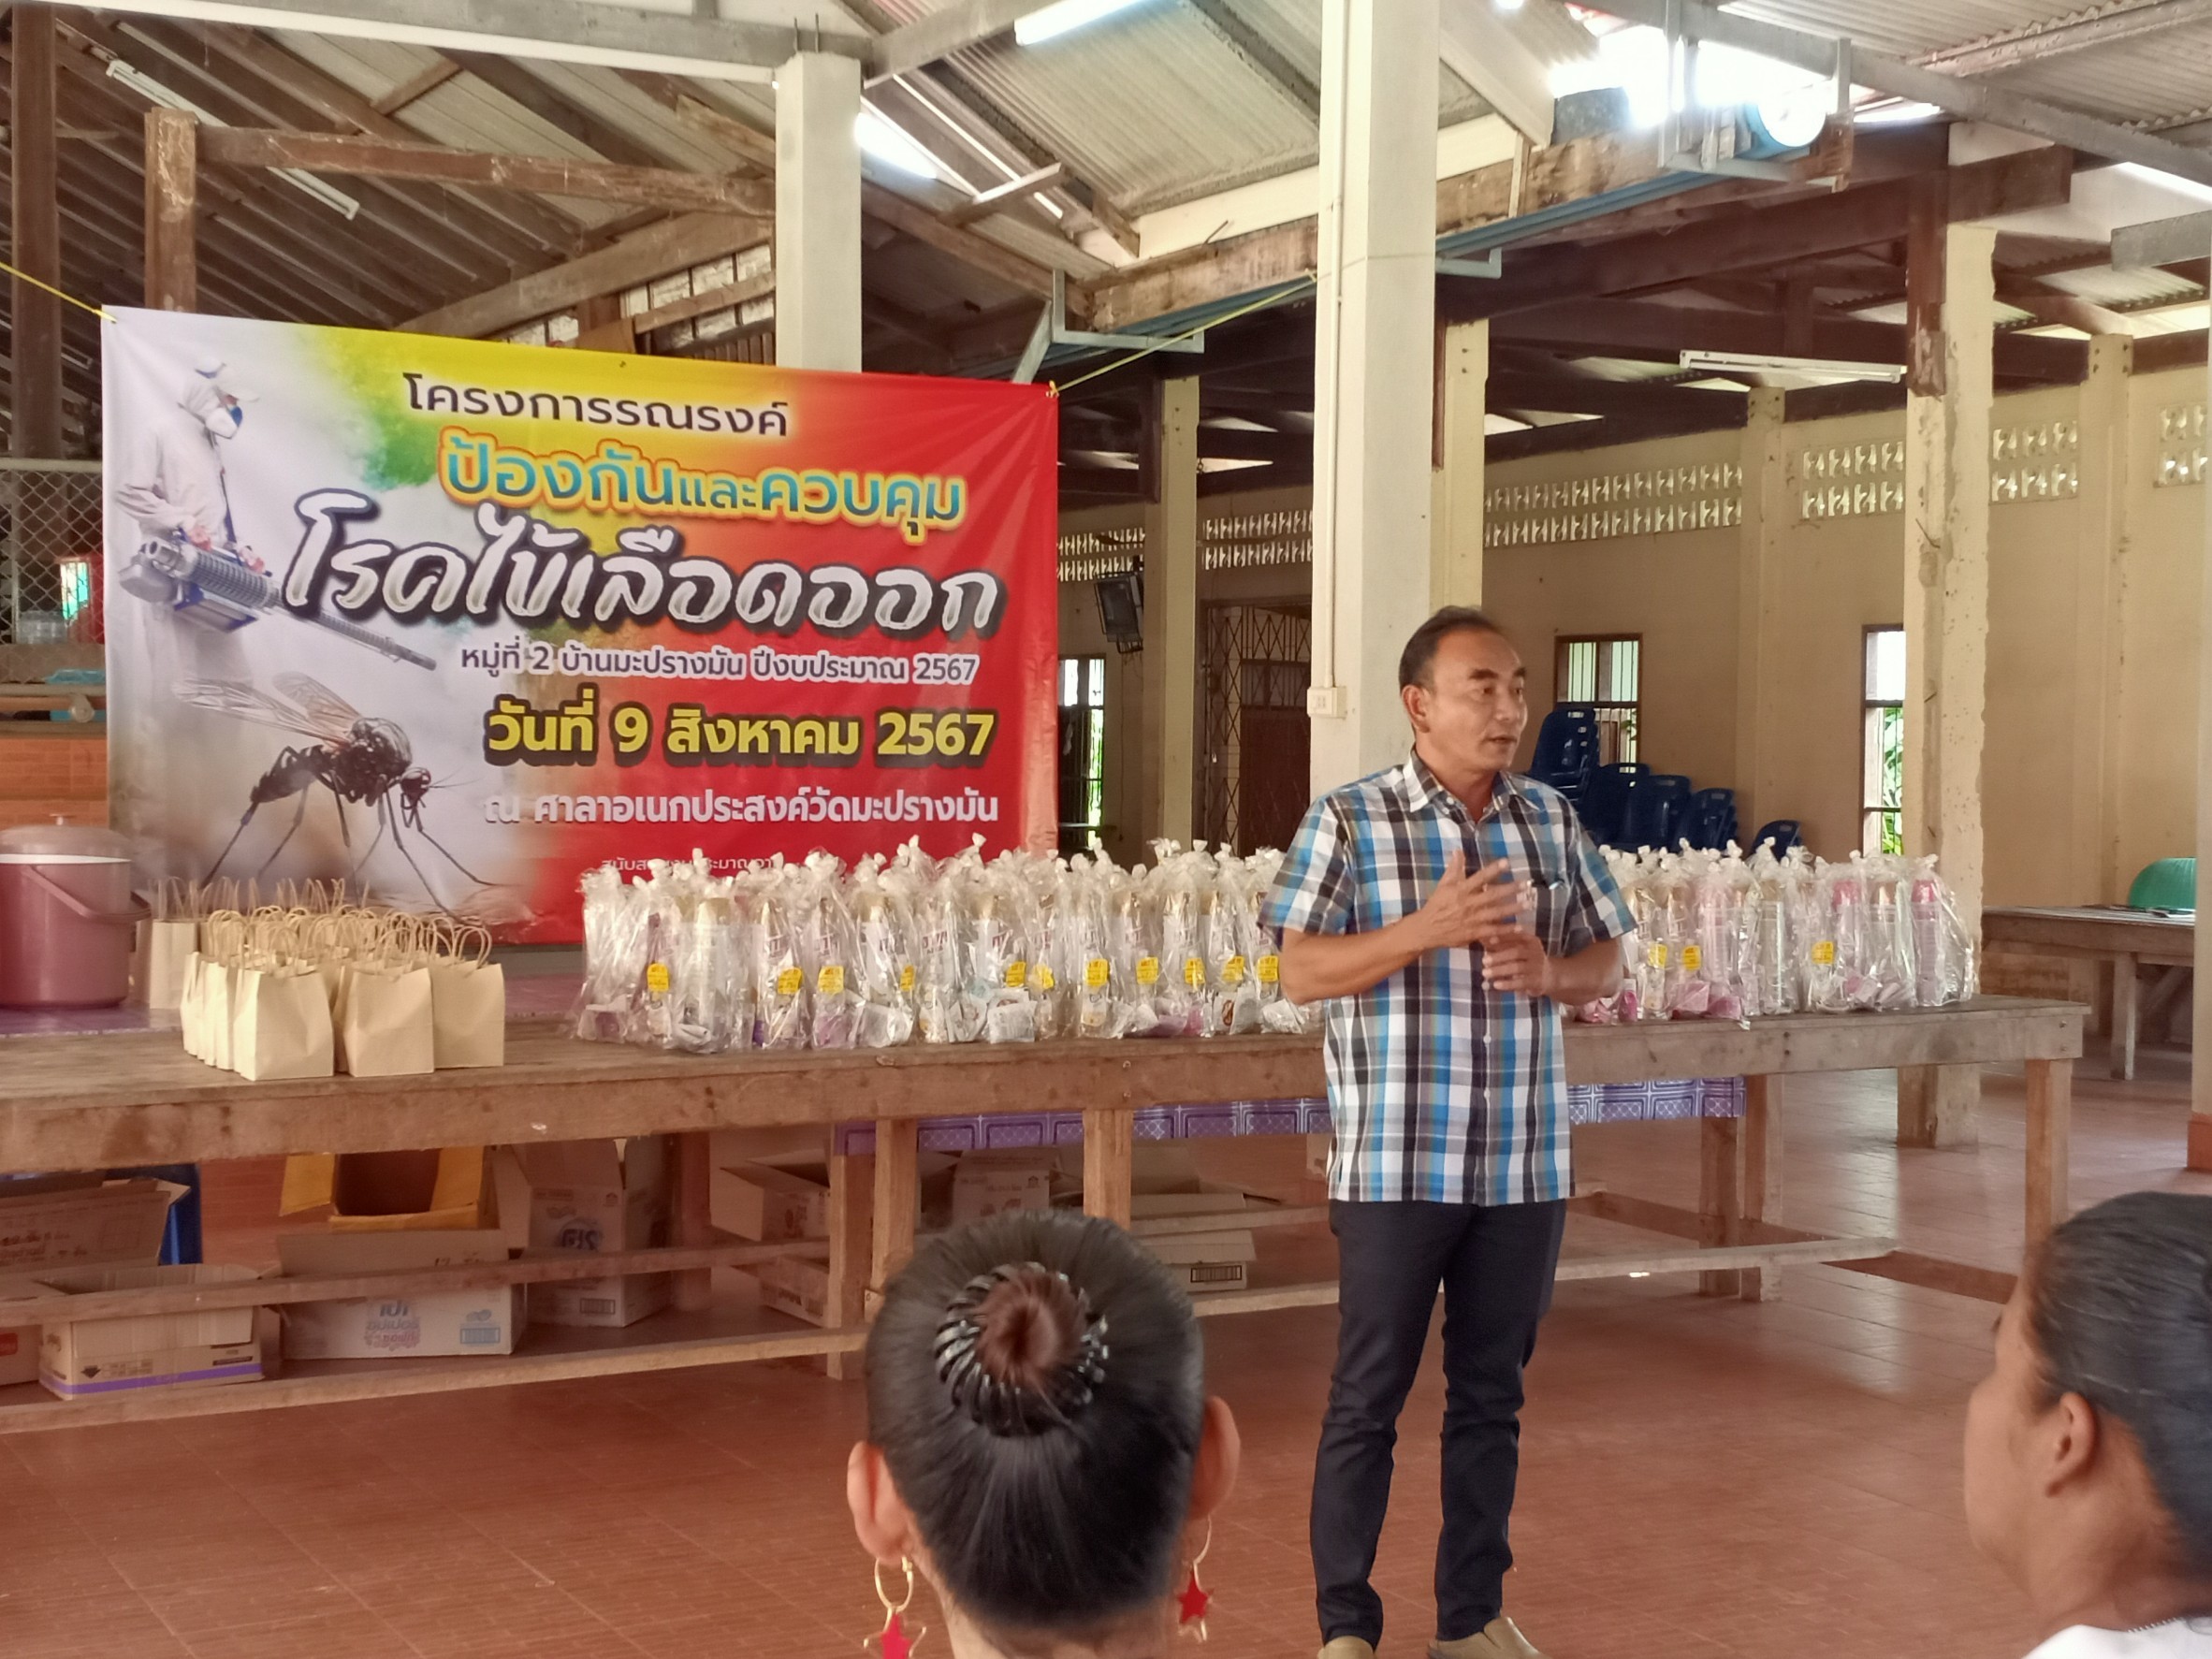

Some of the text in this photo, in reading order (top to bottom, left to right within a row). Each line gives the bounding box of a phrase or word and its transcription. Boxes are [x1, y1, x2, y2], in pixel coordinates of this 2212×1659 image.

[405, 372, 789, 436] โครงการรณรงค์
[445, 433, 966, 537] ป้องกันและควบคุม
[283, 488, 1001, 631] โรคไข้เลือดออก
[461, 636, 979, 684] หมู่ที่ 2 บ้านมะปรางมัน ปีงบประมาณ 2567
[488, 688, 996, 759] วันที่ 9 สิงหาคม 2567
[484, 786, 1000, 825] ณ ศาลาอเนกประสงค์วัดมะปรางมัน
